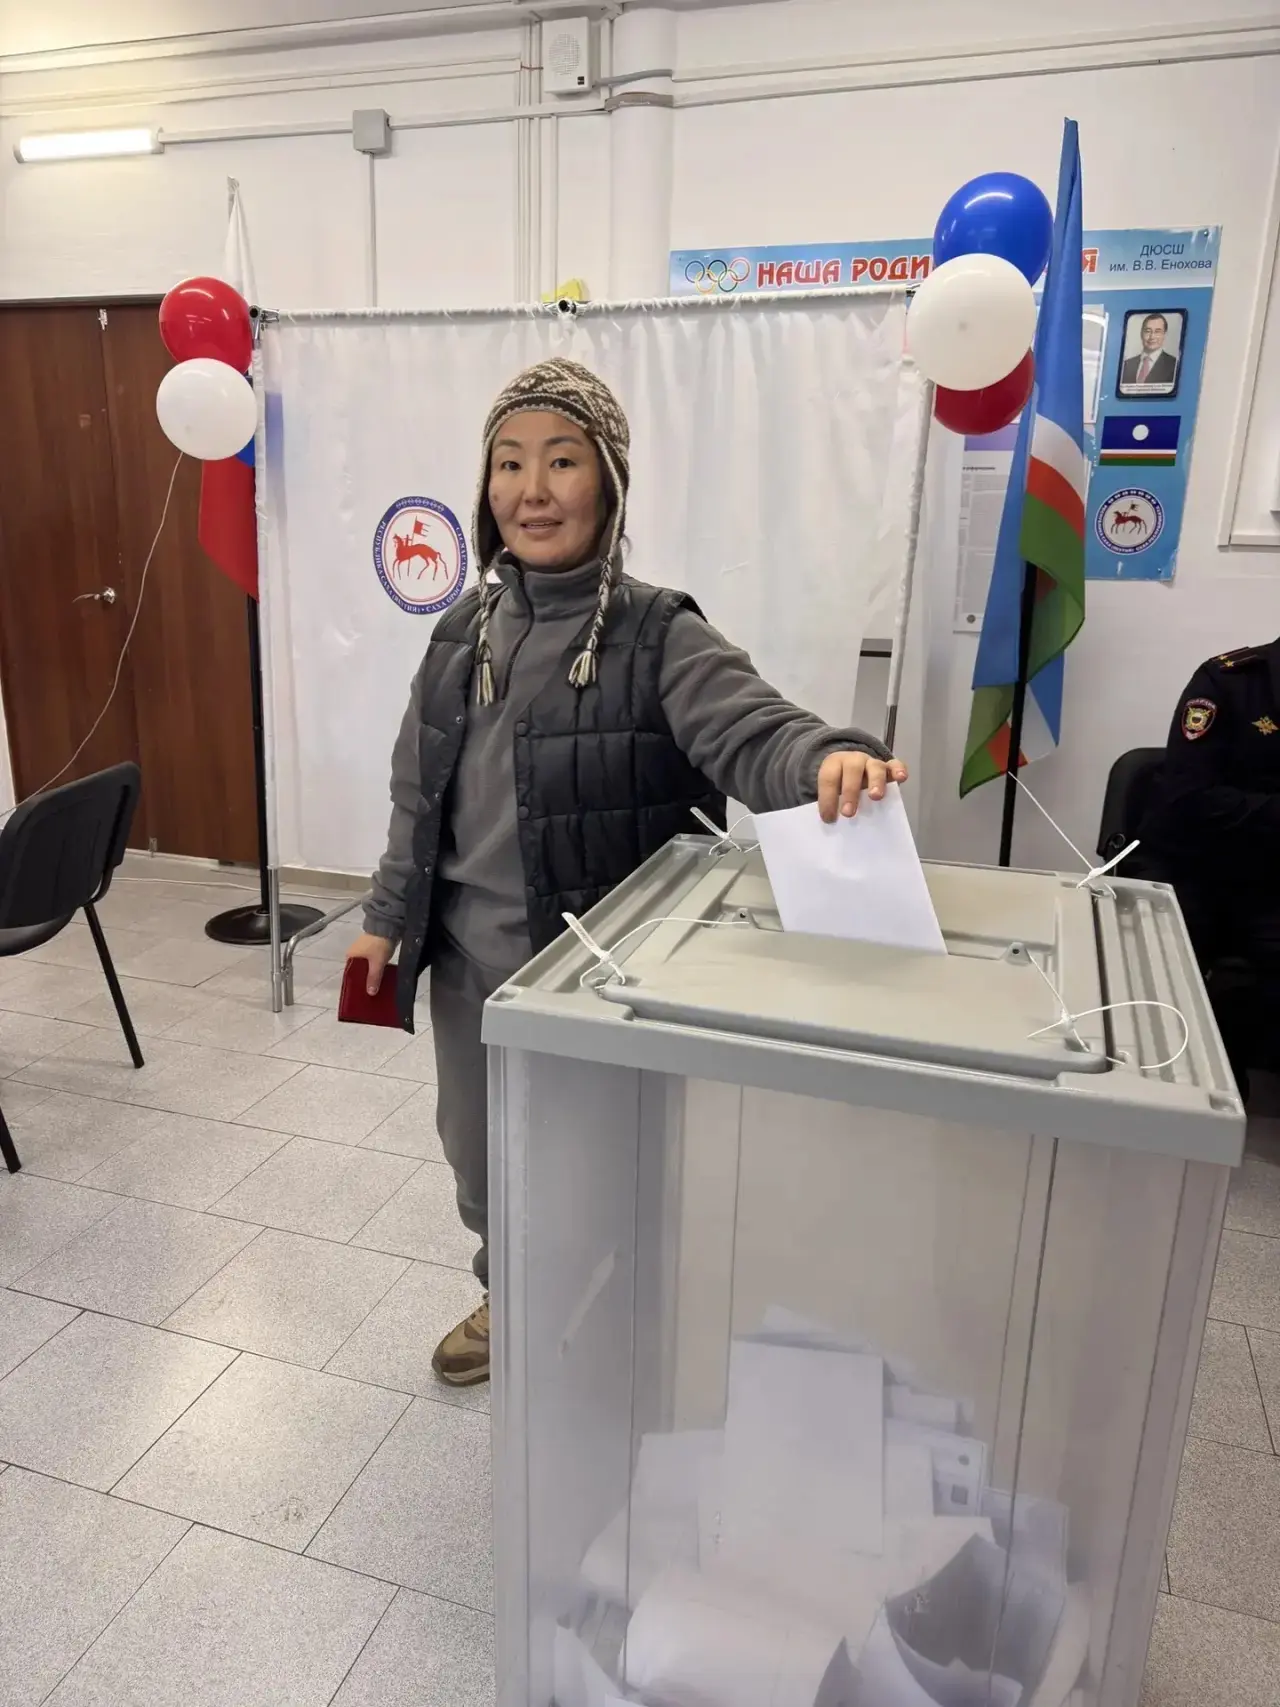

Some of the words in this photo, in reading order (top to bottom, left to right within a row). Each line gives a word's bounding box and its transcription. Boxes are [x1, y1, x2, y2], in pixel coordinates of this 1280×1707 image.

[1140, 244, 1185, 258] ДЮСШ
[757, 258, 841, 288] НАША
[851, 254, 932, 282] РОДИ
[1109, 262, 1129, 272] им.
[1132, 259, 1157, 272] В.В.
[1161, 258, 1212, 271] Енохова
